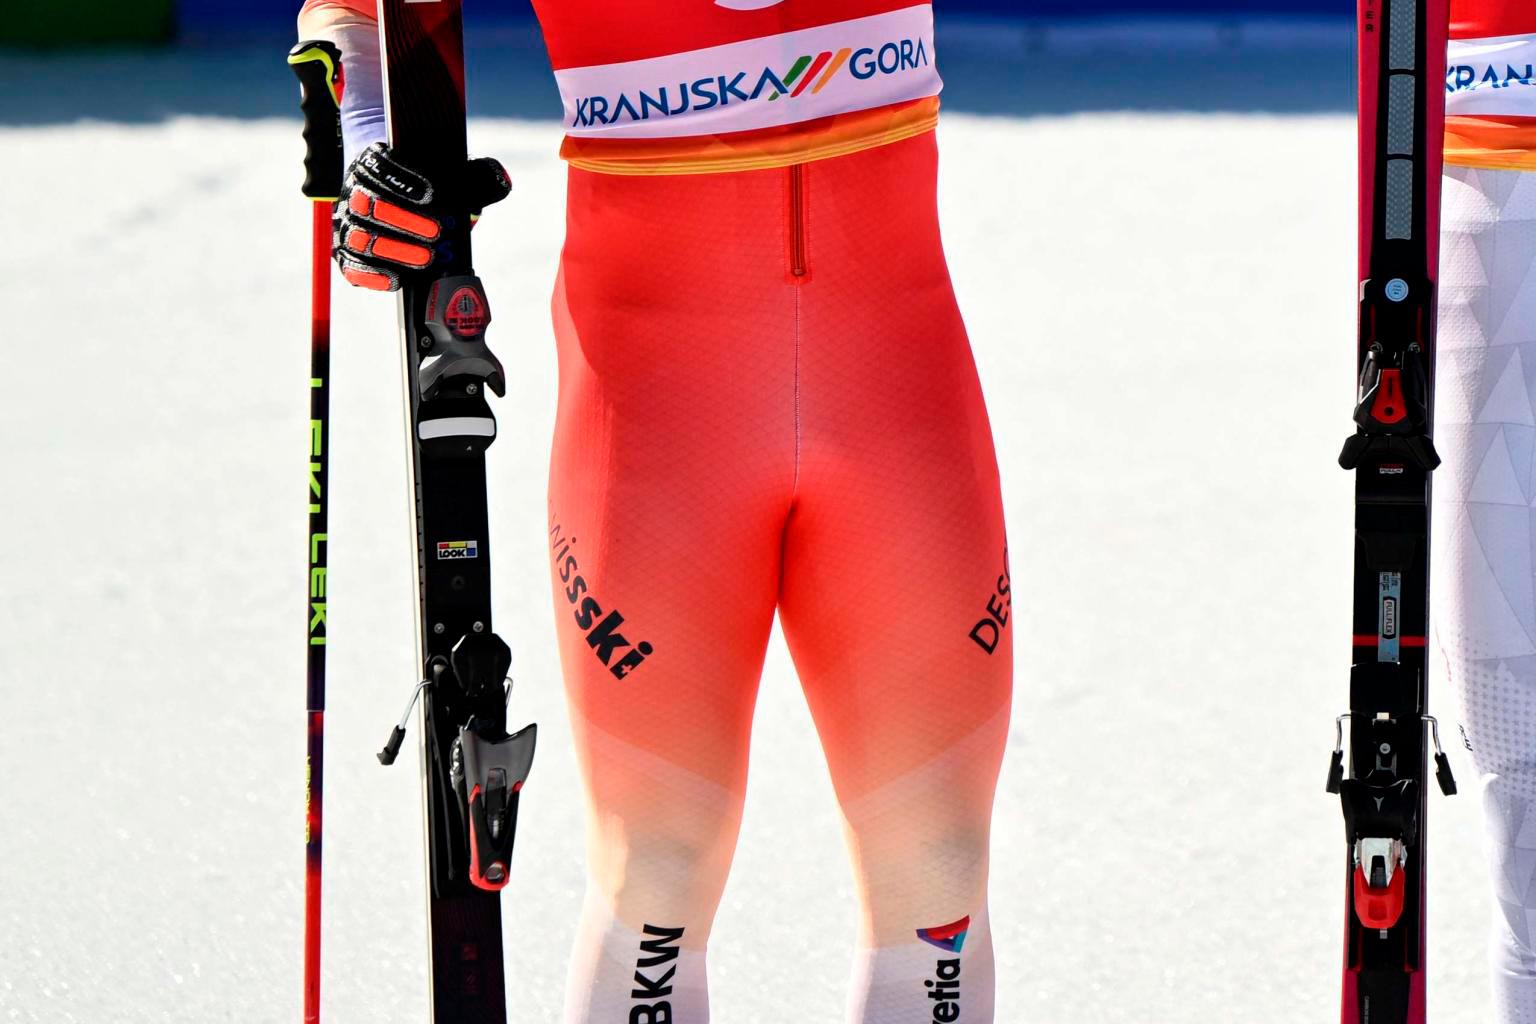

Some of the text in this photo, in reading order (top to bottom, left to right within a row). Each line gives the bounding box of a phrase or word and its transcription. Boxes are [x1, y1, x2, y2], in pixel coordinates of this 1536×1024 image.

[573, 37, 929, 127] KRANJSKA GORA
[309, 532, 328, 645] LEKI
[438, 548, 466, 558] LOOK
[629, 924, 685, 1024] BKW
